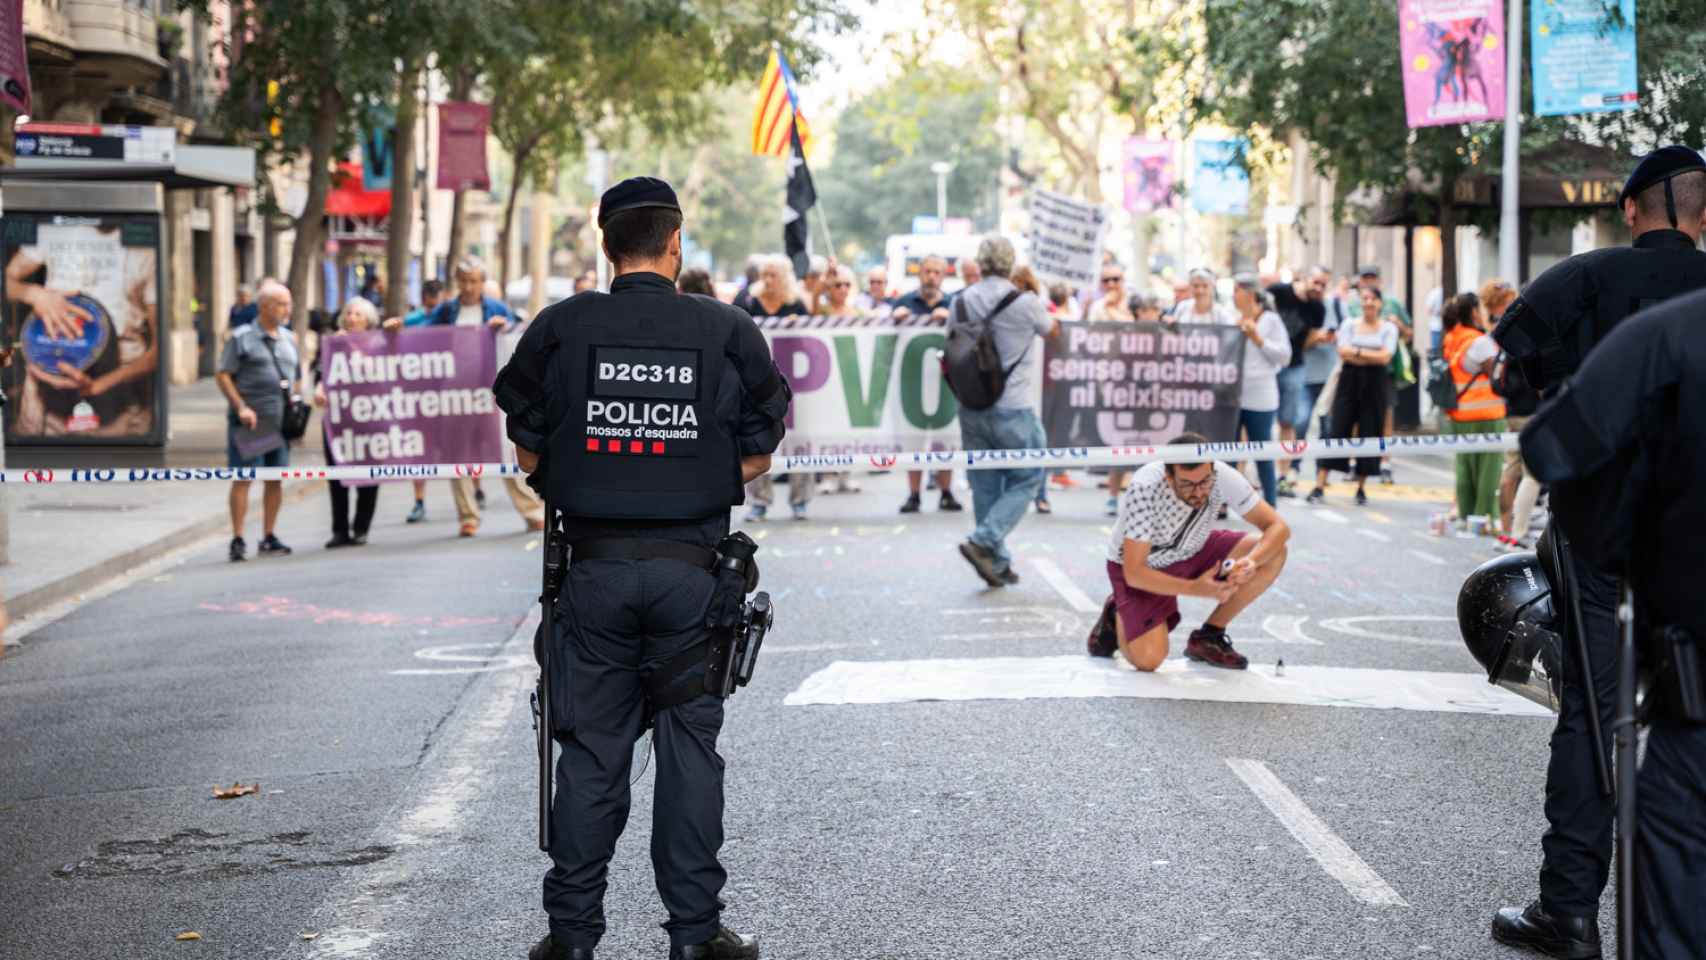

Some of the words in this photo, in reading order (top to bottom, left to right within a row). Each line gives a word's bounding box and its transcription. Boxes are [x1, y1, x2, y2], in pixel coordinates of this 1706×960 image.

[1068, 327, 1115, 354] Per
[1120, 332, 1155, 354] un
[1161, 330, 1220, 356] món
[326, 350, 456, 386] Aturem
[599, 362, 693, 384] D2C318
[1048, 357, 1126, 381] sense
[1132, 356, 1239, 384] racisme
[328, 386, 494, 424] l'extrema
[1069, 383, 1096, 407] ni
[1102, 382, 1216, 411] feixisme
[587, 400, 698, 426] POLICIA
[331, 424, 425, 463] dreta
[586, 426, 632, 437] mossos
[634, 426, 698, 440] d'esquadra
